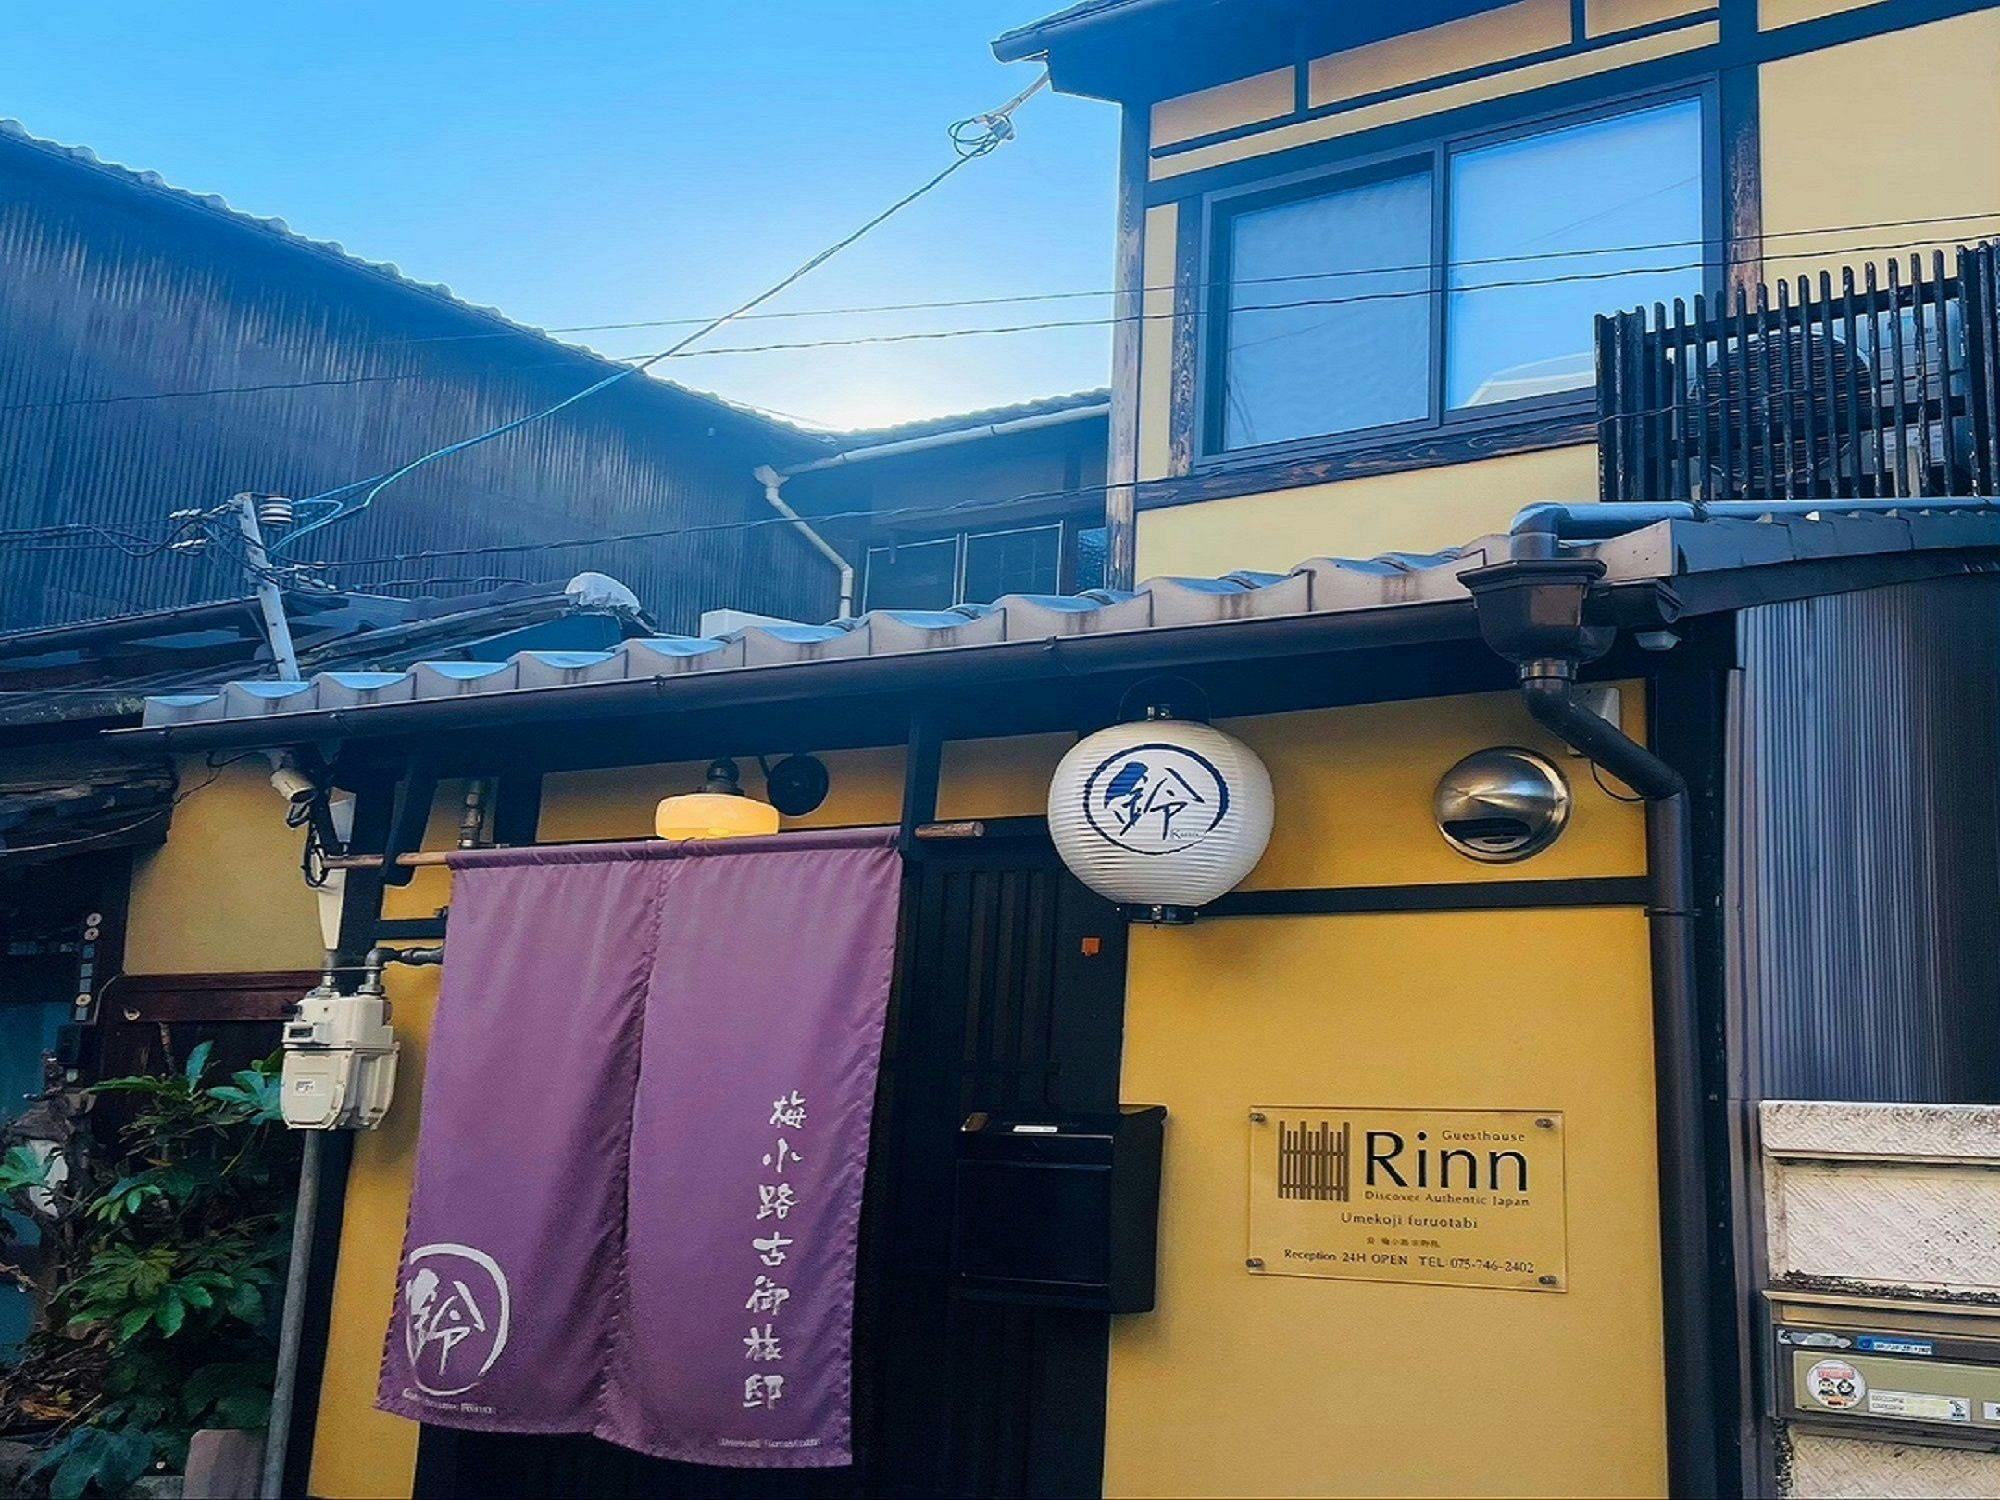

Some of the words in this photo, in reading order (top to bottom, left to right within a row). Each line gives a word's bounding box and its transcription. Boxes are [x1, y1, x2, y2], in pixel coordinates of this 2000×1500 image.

[1442, 1130, 1526, 1142] Guesthouse
[1366, 1131, 1528, 1192] Rinn
[1364, 1190, 1420, 1201] Discover
[1425, 1193, 1486, 1205] Authentic
[1492, 1196, 1531, 1208] Japan
[1341, 1212, 1402, 1228] Umekoji
[1408, 1214, 1478, 1229] furuotabi
[1284, 1249, 1337, 1262] Reception
[1342, 1252, 1366, 1262] 24H
[1371, 1254, 1408, 1265] OPEN
[1419, 1256, 1445, 1268] TEL
